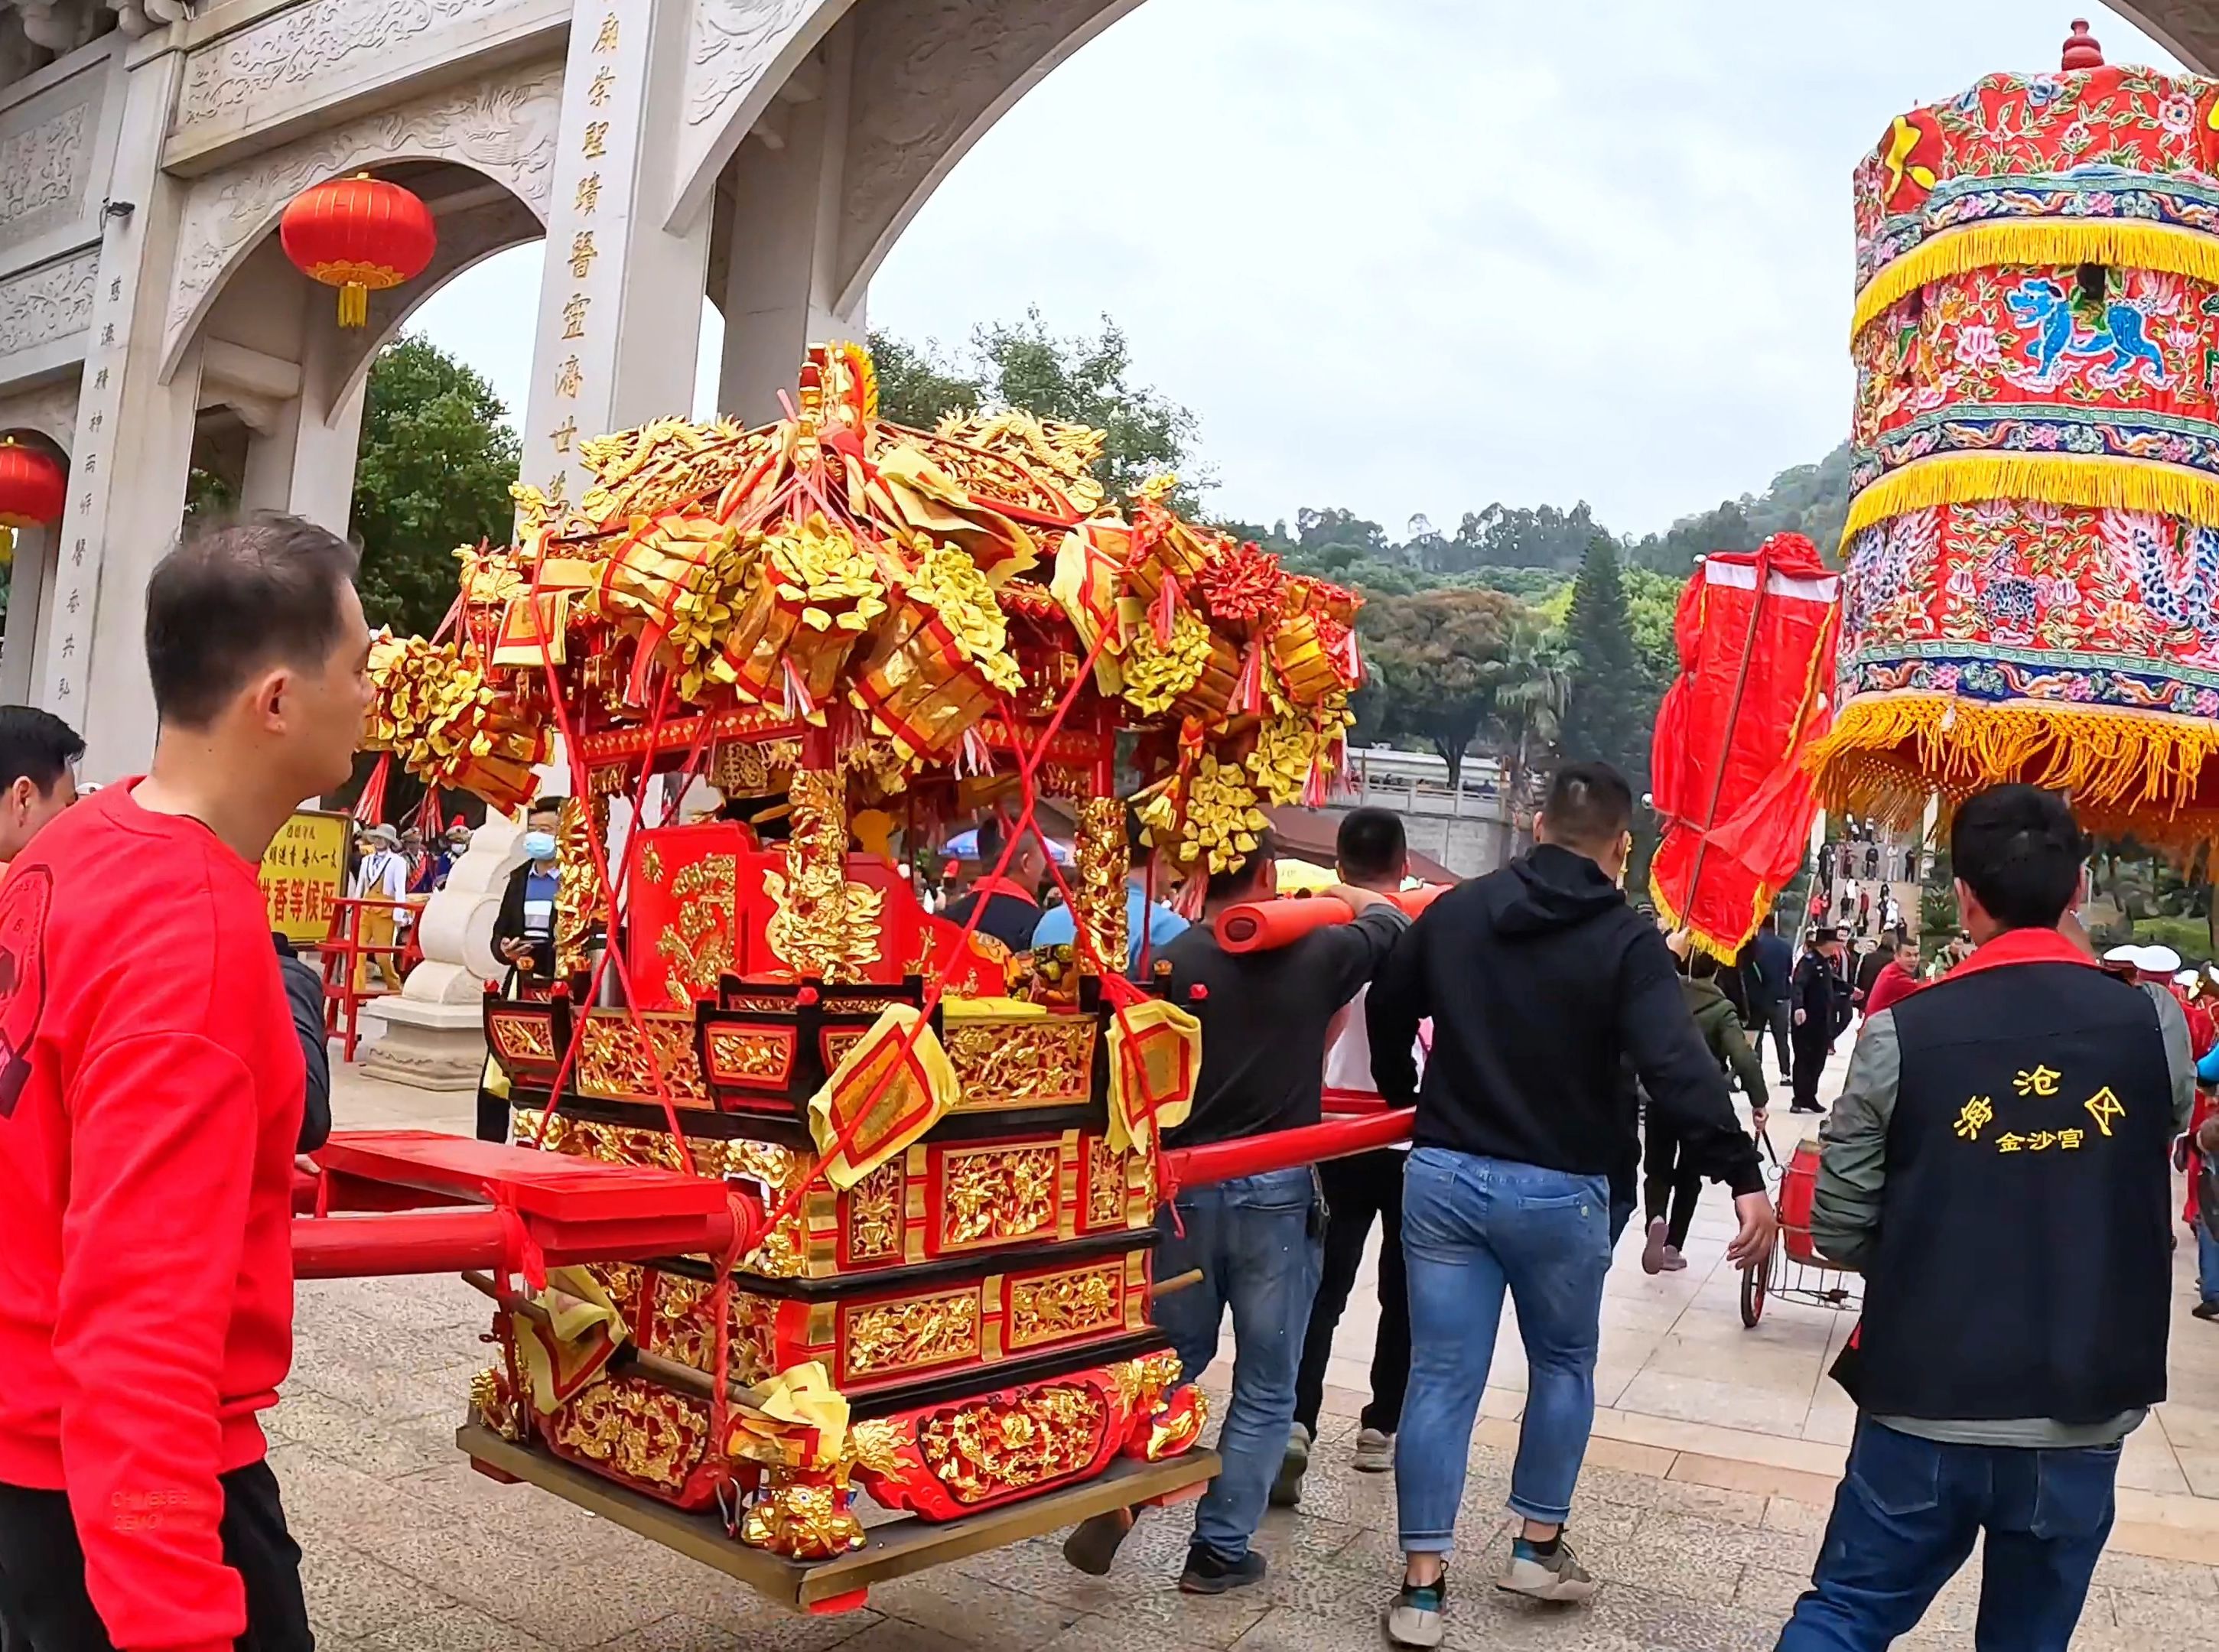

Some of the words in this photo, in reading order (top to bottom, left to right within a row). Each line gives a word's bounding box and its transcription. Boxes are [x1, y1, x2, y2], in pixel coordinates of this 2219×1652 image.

[1953, 1064, 2126, 1141] 海沧区
[1995, 1128, 2084, 1153] 金沙宫
